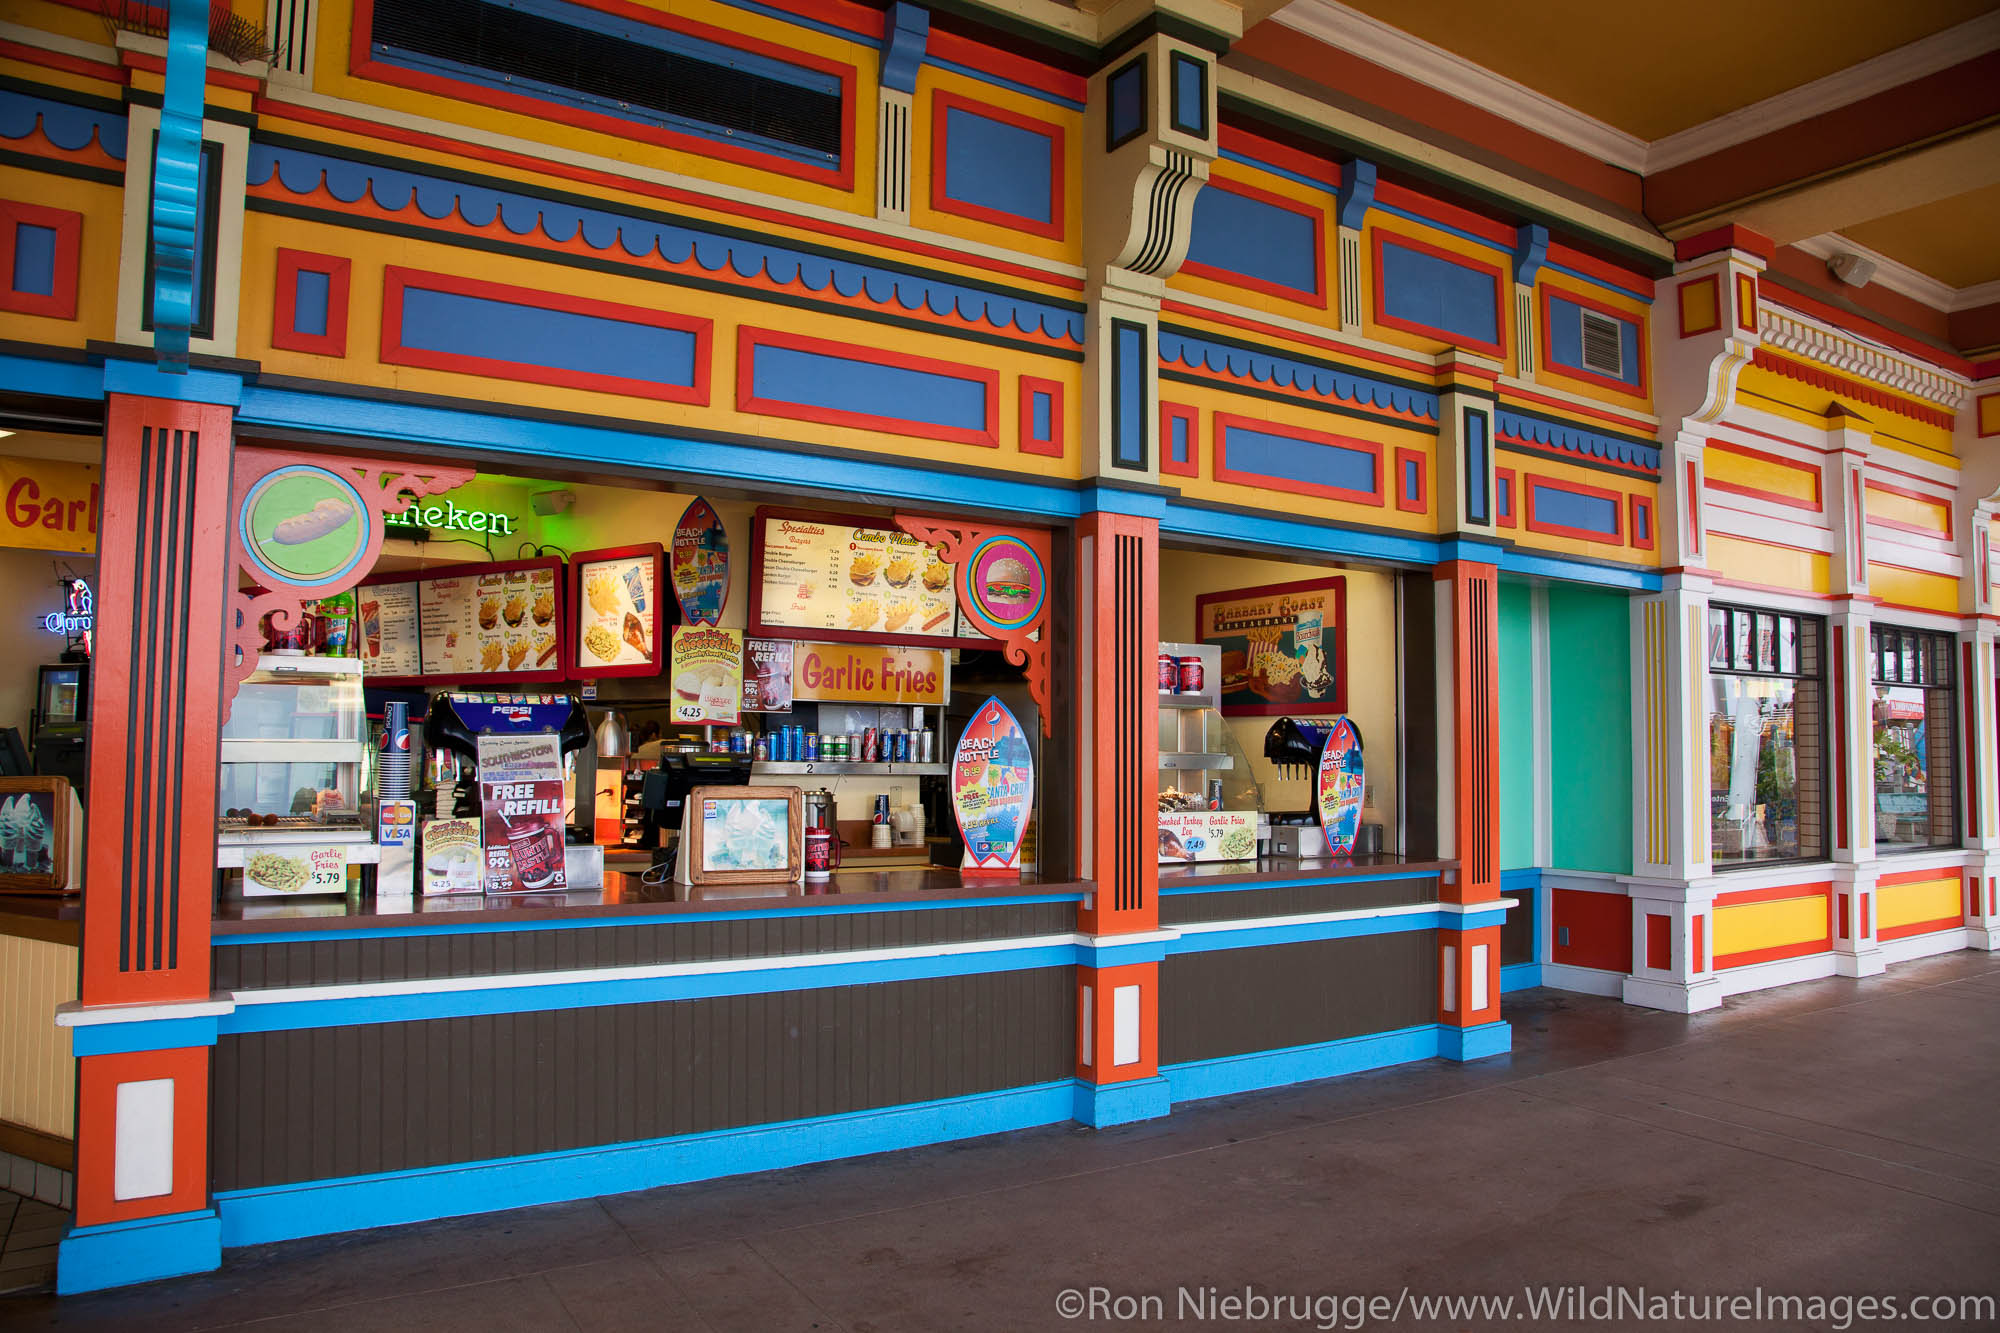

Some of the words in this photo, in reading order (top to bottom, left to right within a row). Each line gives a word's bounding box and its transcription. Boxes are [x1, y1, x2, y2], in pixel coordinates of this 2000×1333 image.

[676, 527, 703, 537] BEACH
[777, 520, 825, 536] Specialties
[675, 537, 706, 547] BOTTLE
[789, 535, 811, 544] Burgers
[853, 528, 886, 543] Combo
[888, 532, 919, 546] Meals
[683, 631, 705, 642] Deep
[705, 629, 730, 641] Fried
[674, 638, 741, 654] Cheesecake
[748, 640, 777, 651] FREE
[755, 651, 790, 663] REFILL
[803, 652, 874, 691] Garlic
[881, 657, 937, 694] Fries
[491, 705, 532, 715] PEPSI
[678, 705, 702, 718] $4.25
[959, 737, 996, 751] BEACH
[958, 749, 999, 763] BOTTLE
[1323, 750, 1345, 761] BEACH
[806, 764, 814, 774] 2
[887, 764, 892, 774] 1
[1322, 760, 1346, 771] BOTTLE
[491, 783, 535, 800] FREE
[503, 798, 561, 816] REFILL
[1183, 815, 1203, 827] Turkey
[1209, 815, 1229, 826] Garlic
[1230, 815, 1246, 825] Fries
[1181, 826, 1193, 837] Leg
[1186, 840, 1205, 850] 7.49
[311, 848, 343, 861] Garlic
[315, 860, 339, 871] Fries
[312, 871, 340, 884] $5.79
[487, 881, 513, 890] $8.99
